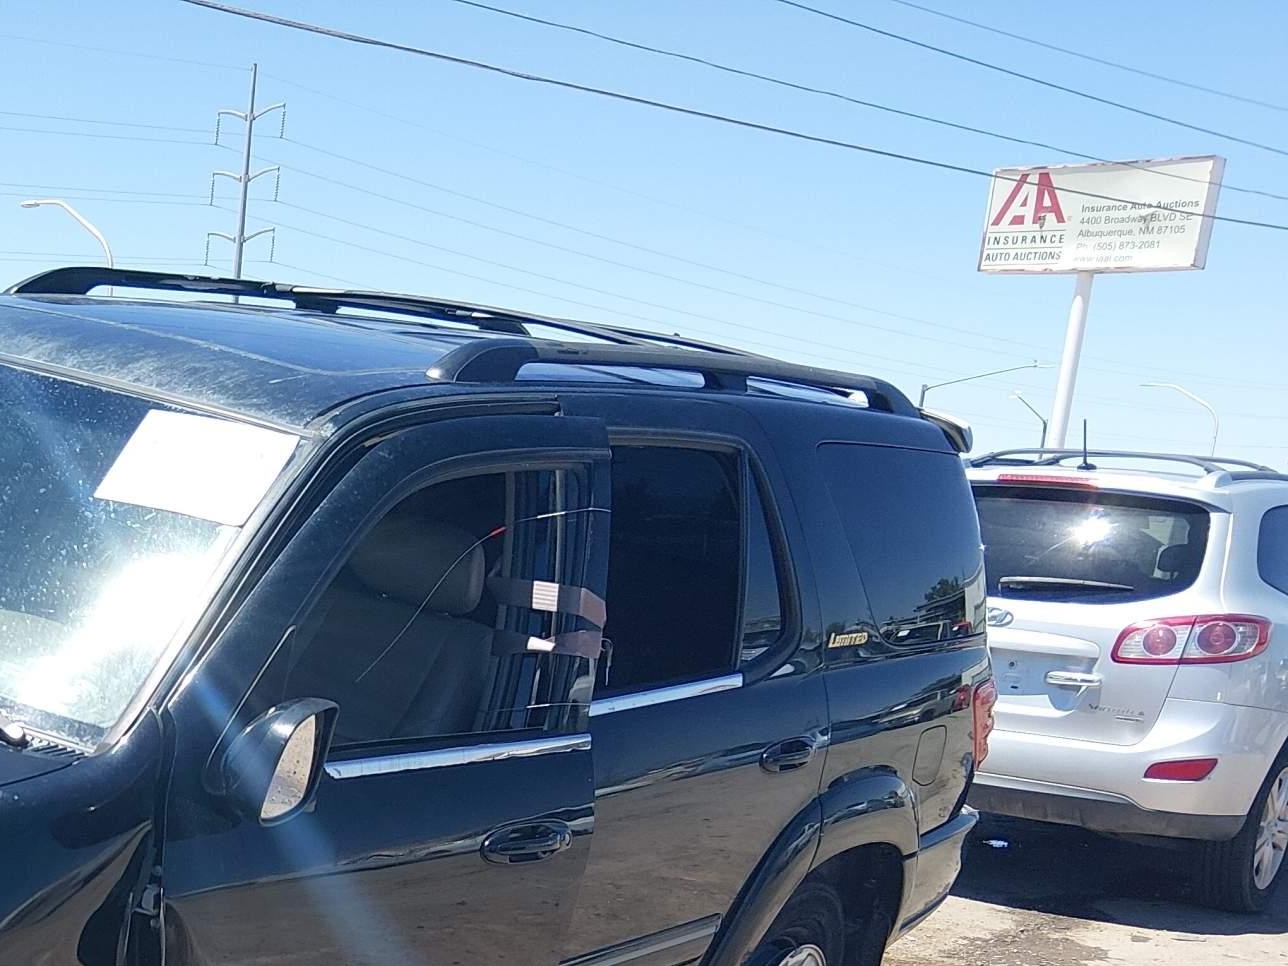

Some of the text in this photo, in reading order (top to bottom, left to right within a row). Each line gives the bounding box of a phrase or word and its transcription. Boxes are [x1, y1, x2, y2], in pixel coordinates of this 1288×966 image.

[1081, 200, 1200, 213] Insurance Auto Auctions
[1080, 212, 1193, 225] 4400 Broadway BLVD SE
[1138, 226, 1155, 236] NM
[1156, 225, 1186, 234] 87105
[987, 234, 1065, 246] INSURANCE
[1092, 241, 1117, 251] (505)
[1118, 240, 1160, 250] 873-2081
[984, 250, 1062, 262] AUTO AUCTIONS
